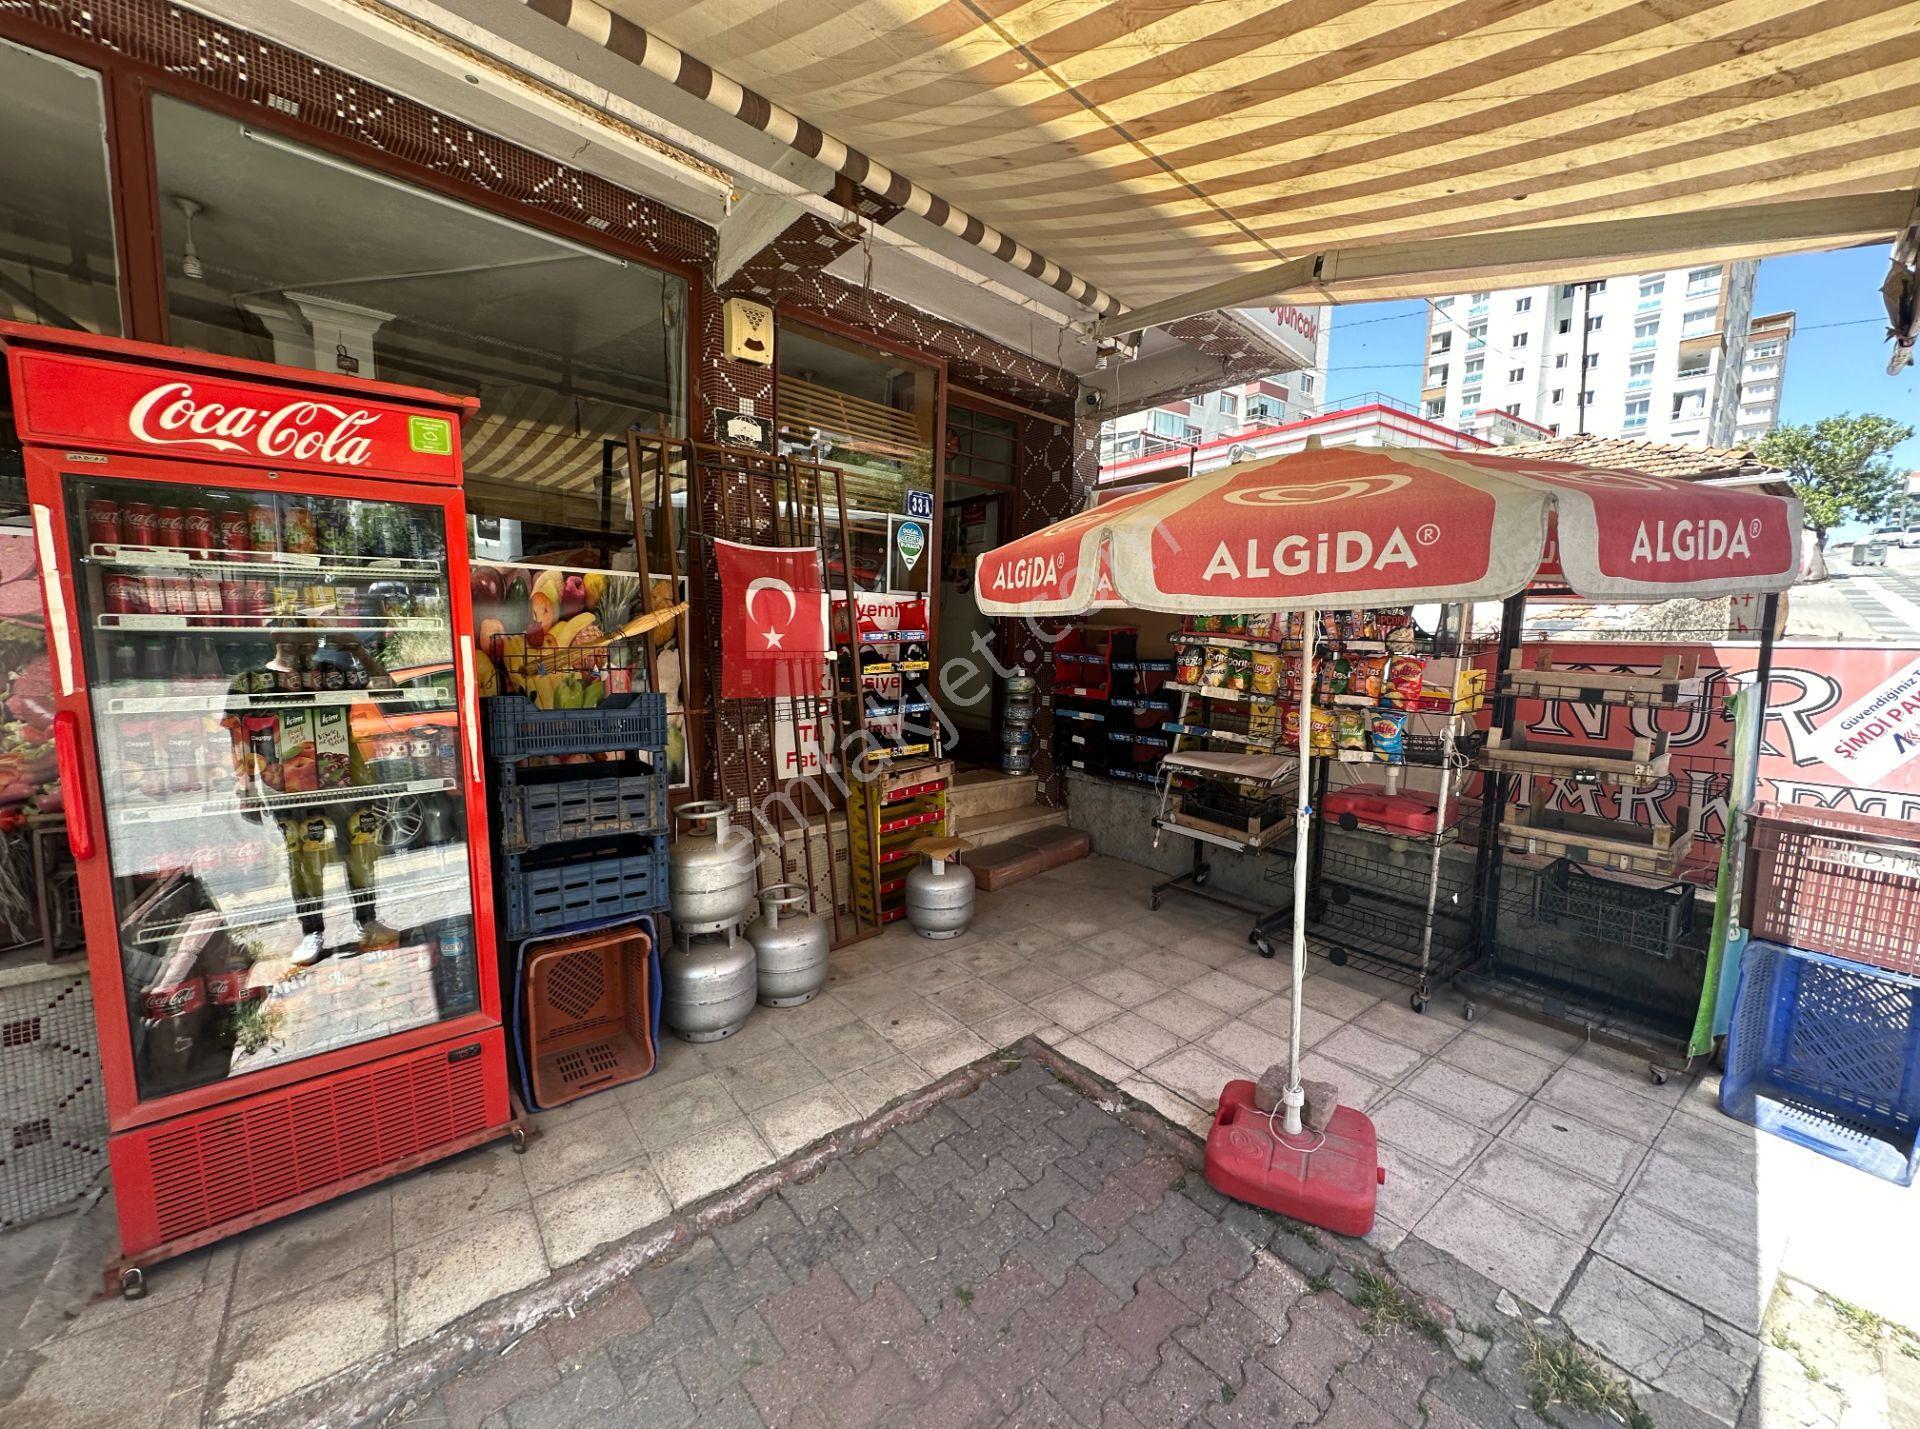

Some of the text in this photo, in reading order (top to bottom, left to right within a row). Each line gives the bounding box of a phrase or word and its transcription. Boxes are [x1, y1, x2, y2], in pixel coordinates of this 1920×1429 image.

[129, 382, 383, 466] Coca-Cola
[857, 601, 898, 620] yemi
[1526, 662, 1842, 767] NUR
[1841, 676, 1917, 730] Güvendiğiniz
[1834, 716, 1892, 760] ŞİMDİ
